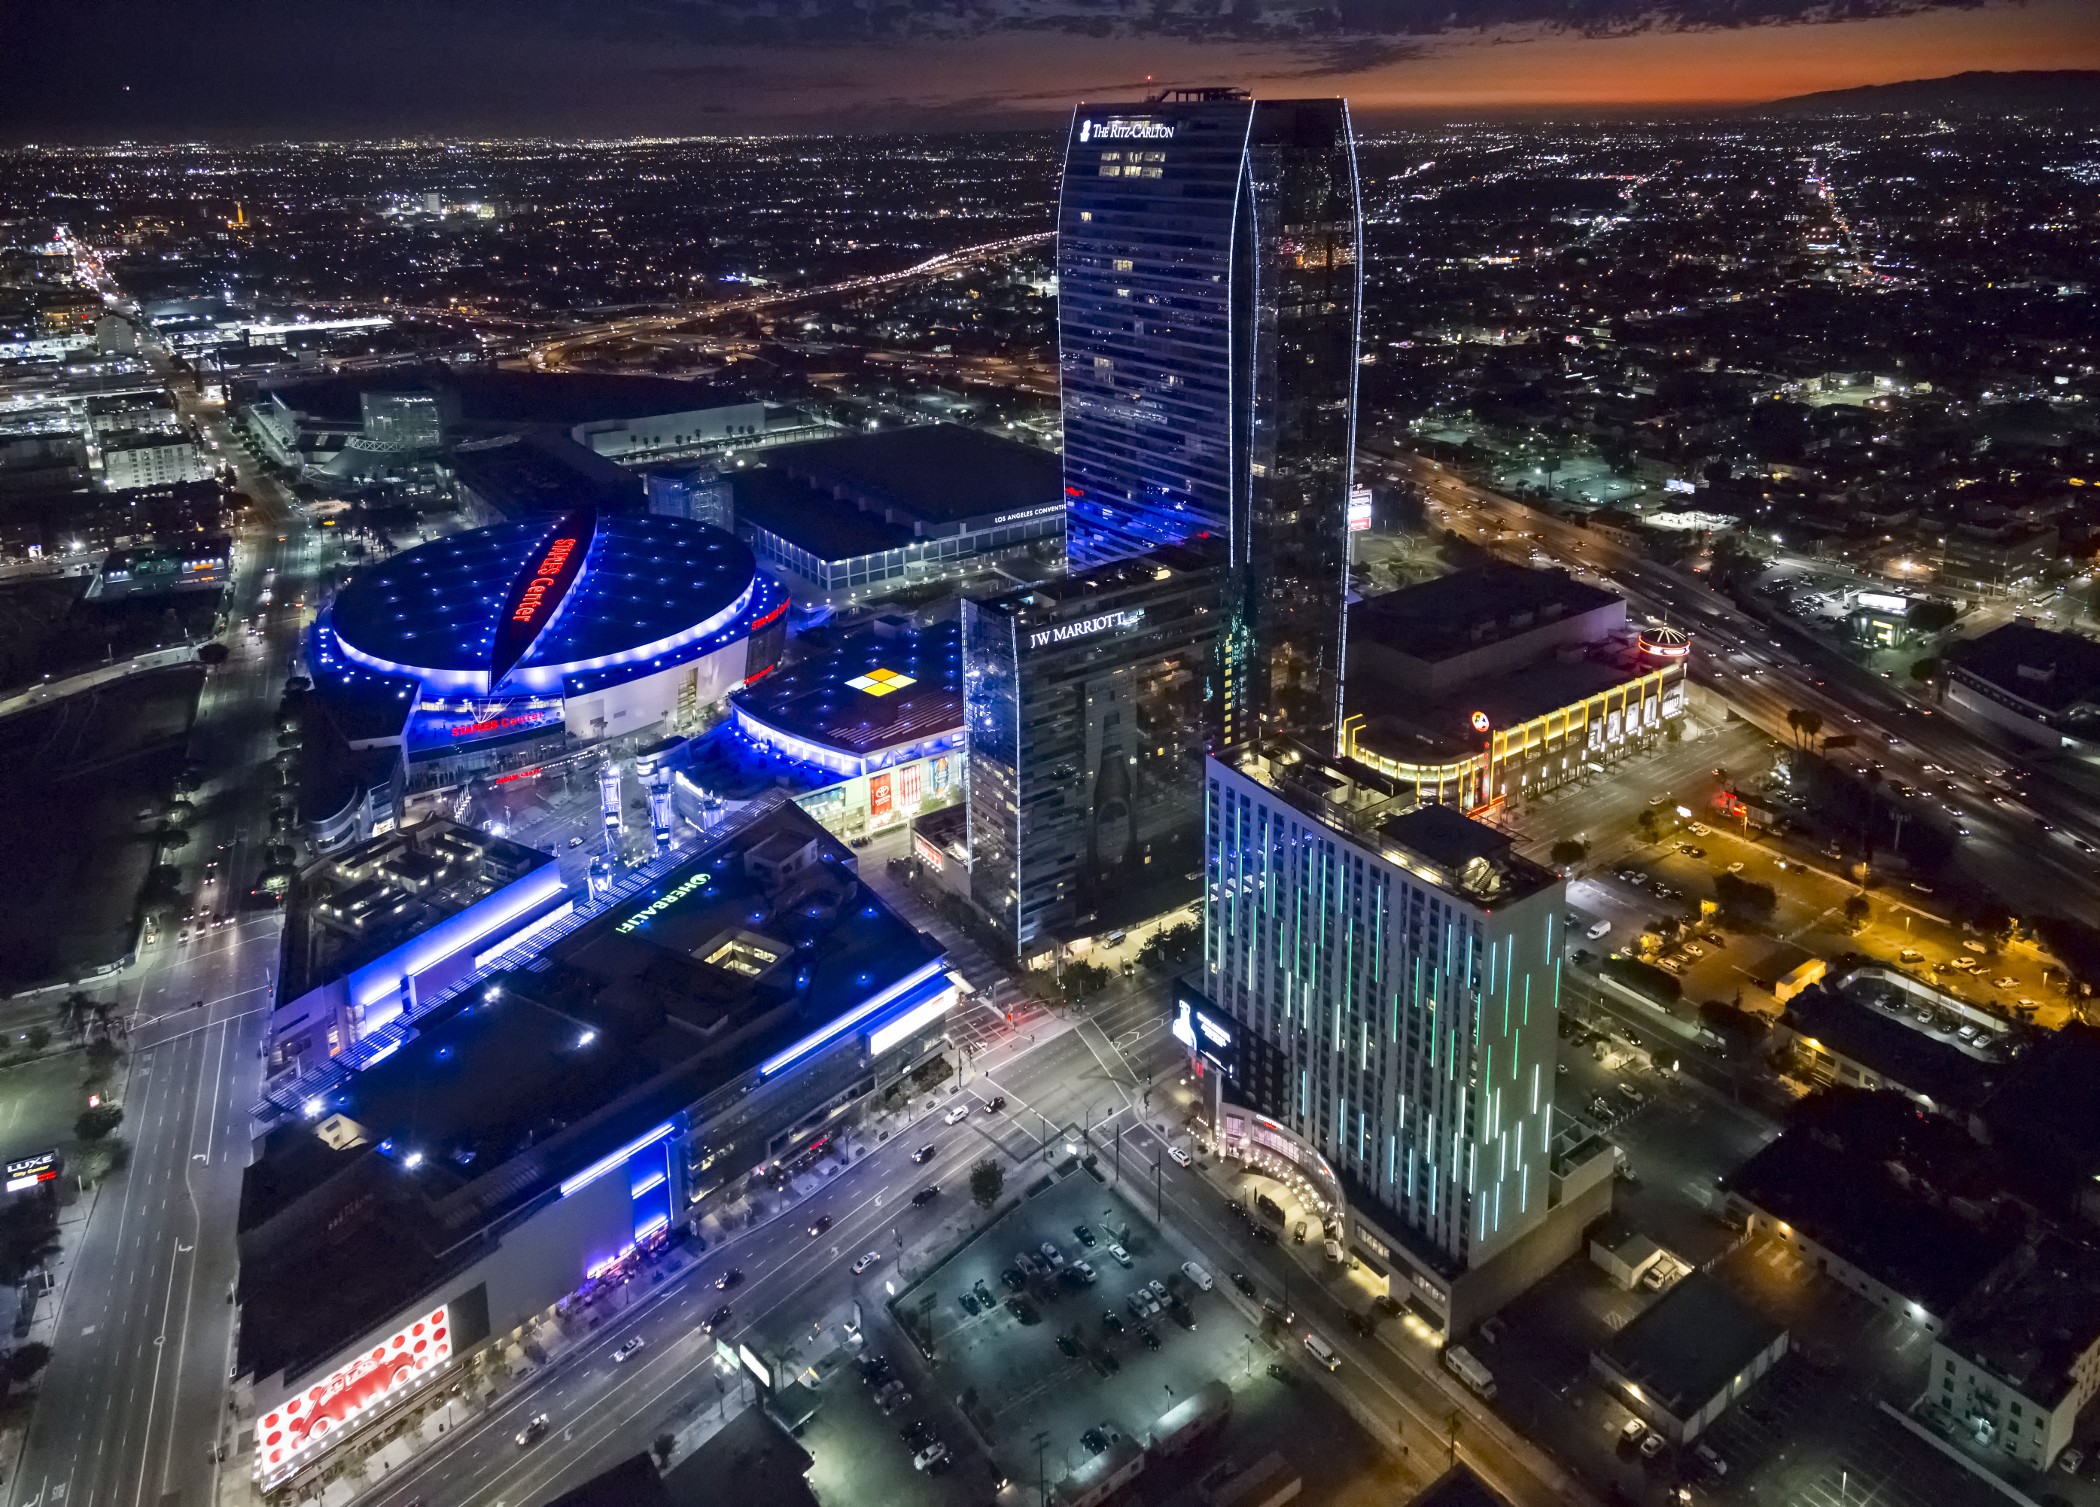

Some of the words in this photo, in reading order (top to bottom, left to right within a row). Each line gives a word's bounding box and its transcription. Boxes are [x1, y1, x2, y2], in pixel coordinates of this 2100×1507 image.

[1093, 123, 1109, 138] THE
[1109, 123, 1174, 138] RITZ-CARLTON
[994, 515, 1006, 524] LOS
[1007, 510, 1034, 521] ANGELES
[537, 538, 576, 575] STAPLES
[512, 577, 554, 622] Center
[1030, 630, 1051, 649] JW
[1052, 611, 1125, 642] MARRIOTT
[451, 719, 499, 737] STAPLES
[501, 711, 544, 727] Center
[7, 1155, 54, 1173] LUXE
